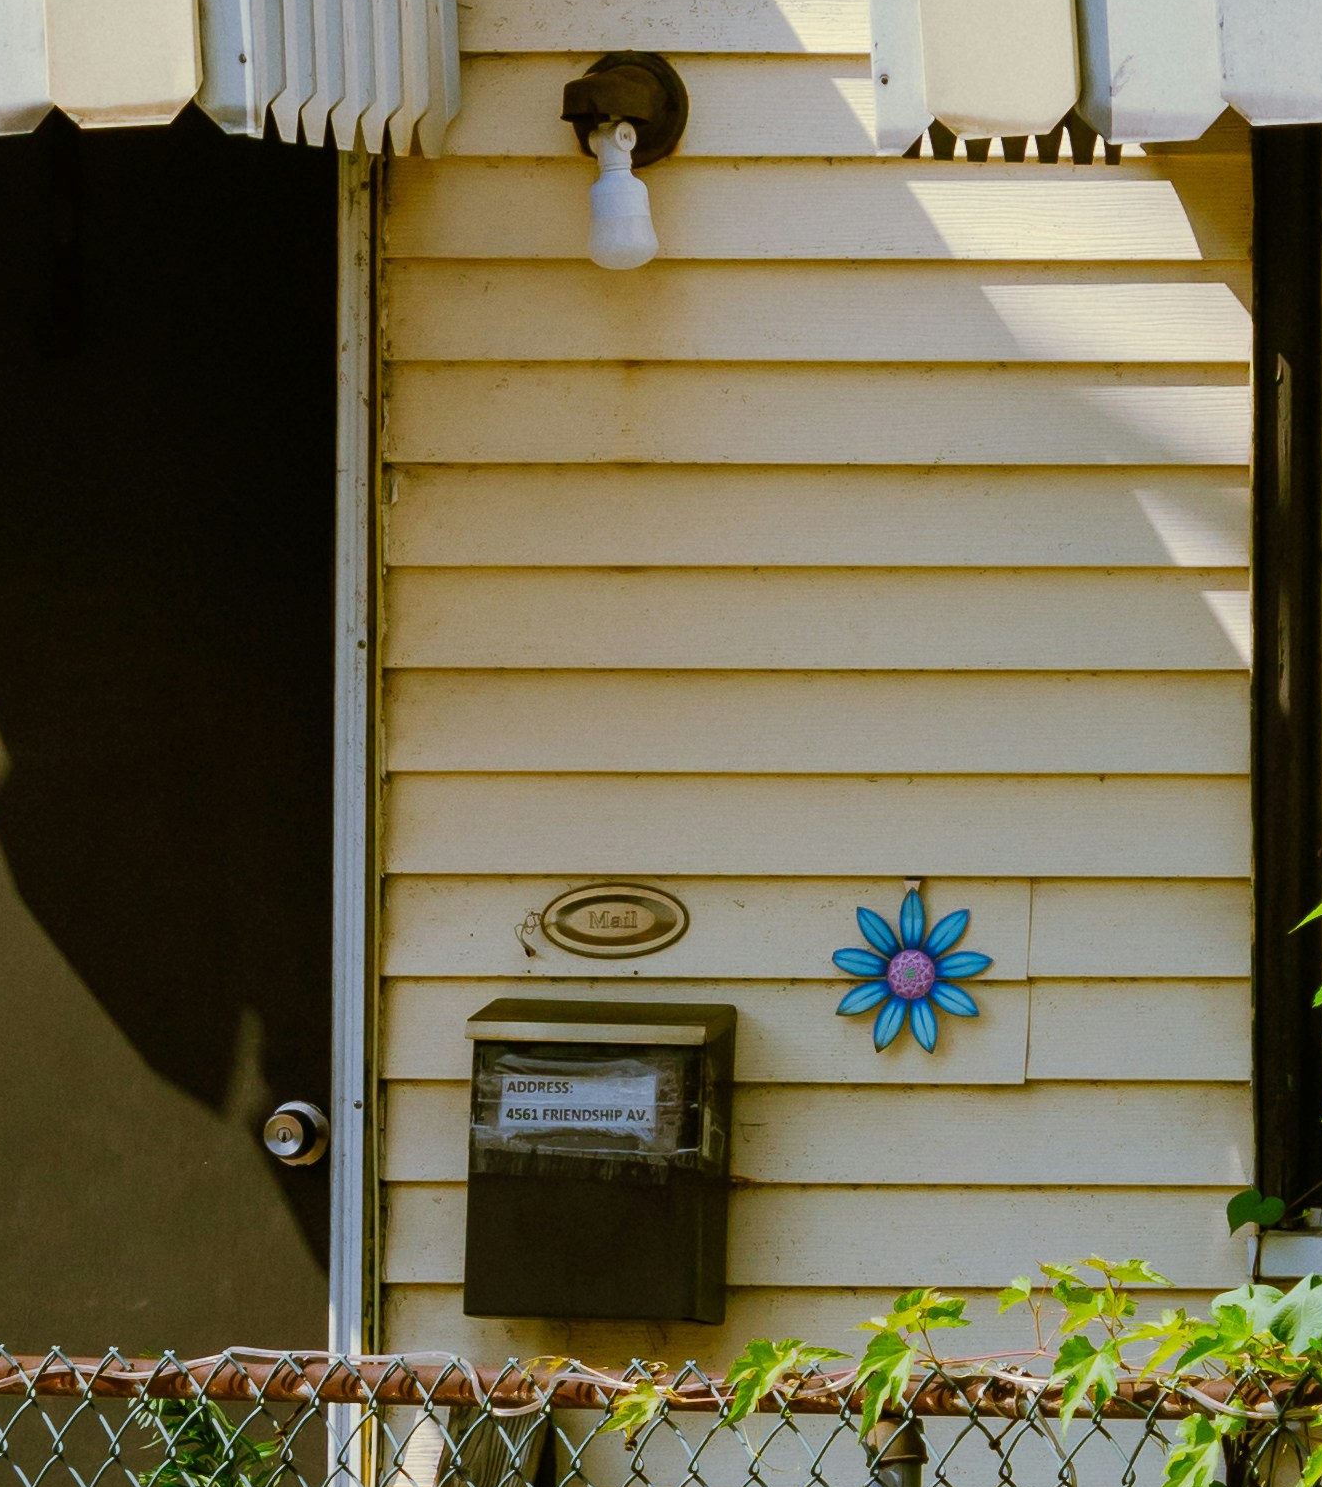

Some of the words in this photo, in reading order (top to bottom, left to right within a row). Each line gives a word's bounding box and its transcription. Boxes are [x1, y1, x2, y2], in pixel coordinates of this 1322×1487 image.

[588, 910, 638, 929] Mail
[506, 1080, 574, 1094] ADDRESS:
[506, 1108, 539, 1121] 4561
[542, 1108, 623, 1122] FRIENDSHIP
[625, 1108, 650, 1122] AV.
